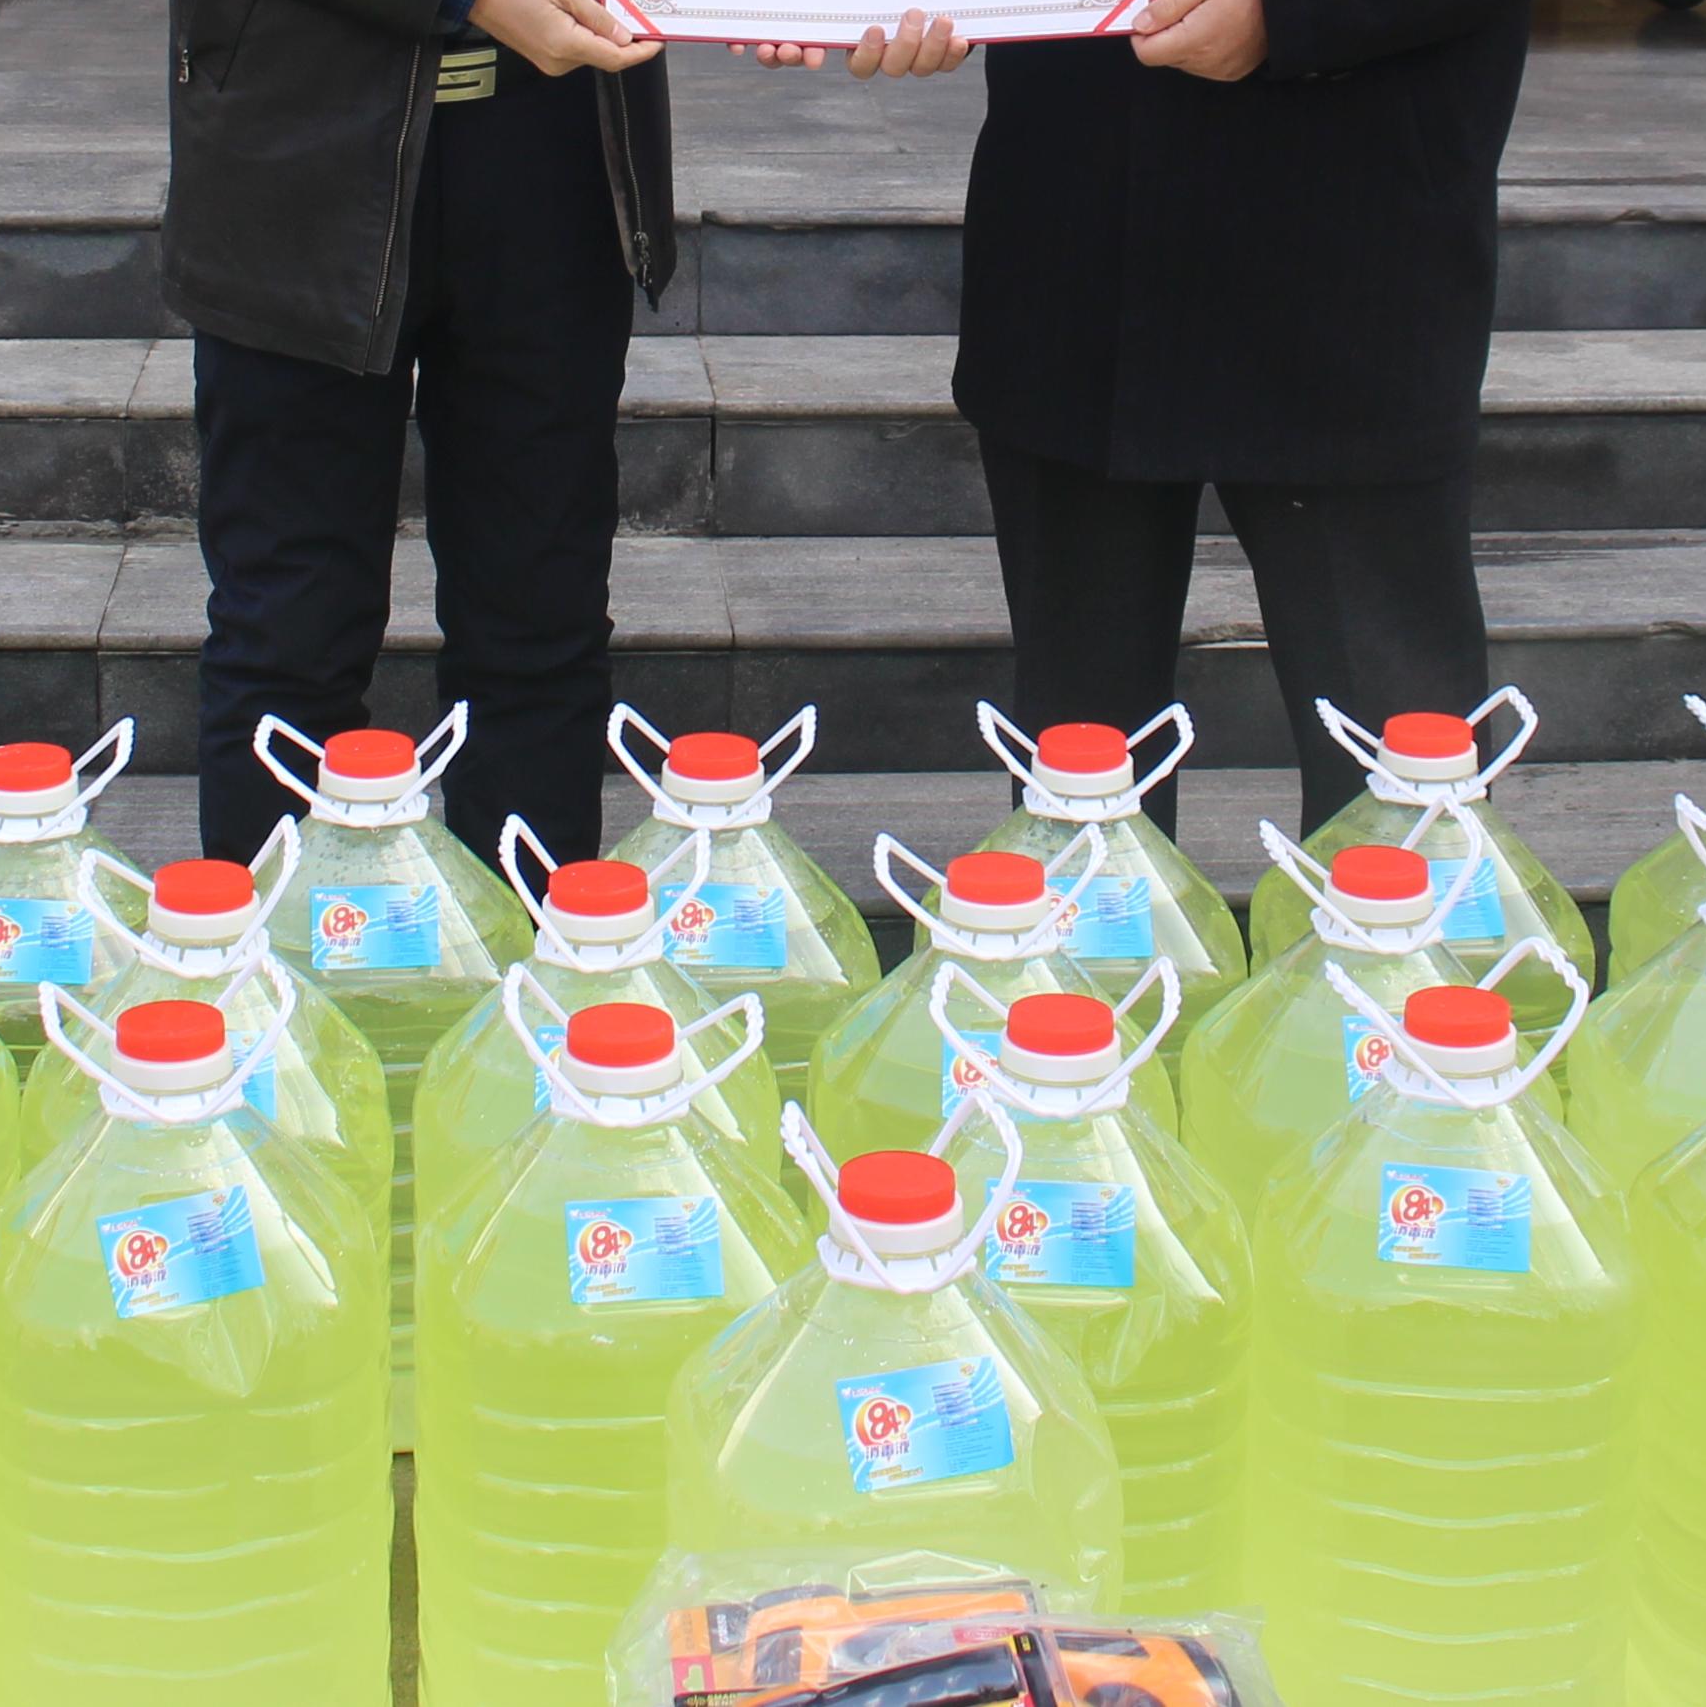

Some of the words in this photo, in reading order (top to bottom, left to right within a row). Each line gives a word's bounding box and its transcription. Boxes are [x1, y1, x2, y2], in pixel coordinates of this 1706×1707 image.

[332, 906, 359, 934] 84
[680, 901, 706, 929] 84
[1007, 1204, 1037, 1240] 84
[1402, 1189, 1431, 1221] 84
[127, 1234, 159, 1270] 84
[590, 1224, 623, 1261] 84
[867, 1401, 903, 1441] 84
